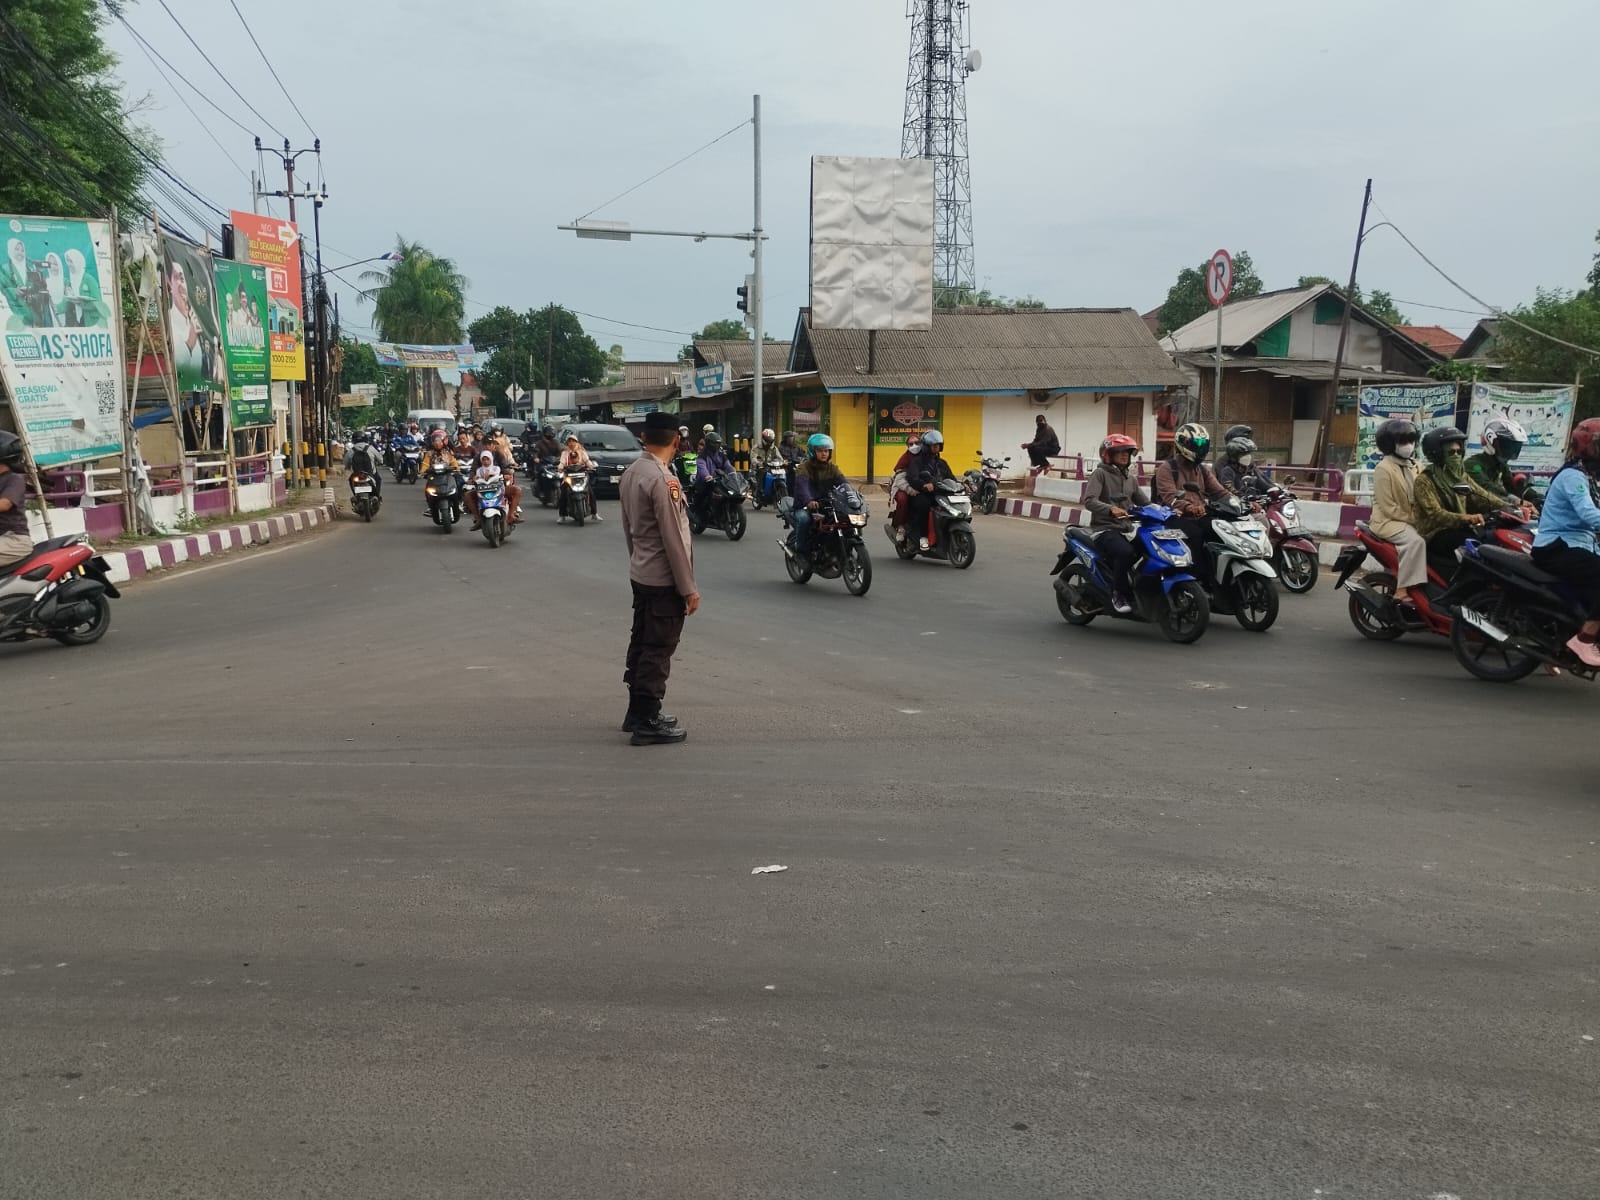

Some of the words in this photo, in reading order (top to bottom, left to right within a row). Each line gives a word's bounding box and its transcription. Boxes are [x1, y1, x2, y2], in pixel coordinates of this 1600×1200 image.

[40, 334, 113, 360] AS-SHOFA
[15, 385, 58, 395] BEASISWA
[1379, 387, 1403, 397] SMP
[17, 394, 49, 404] GRATIS
